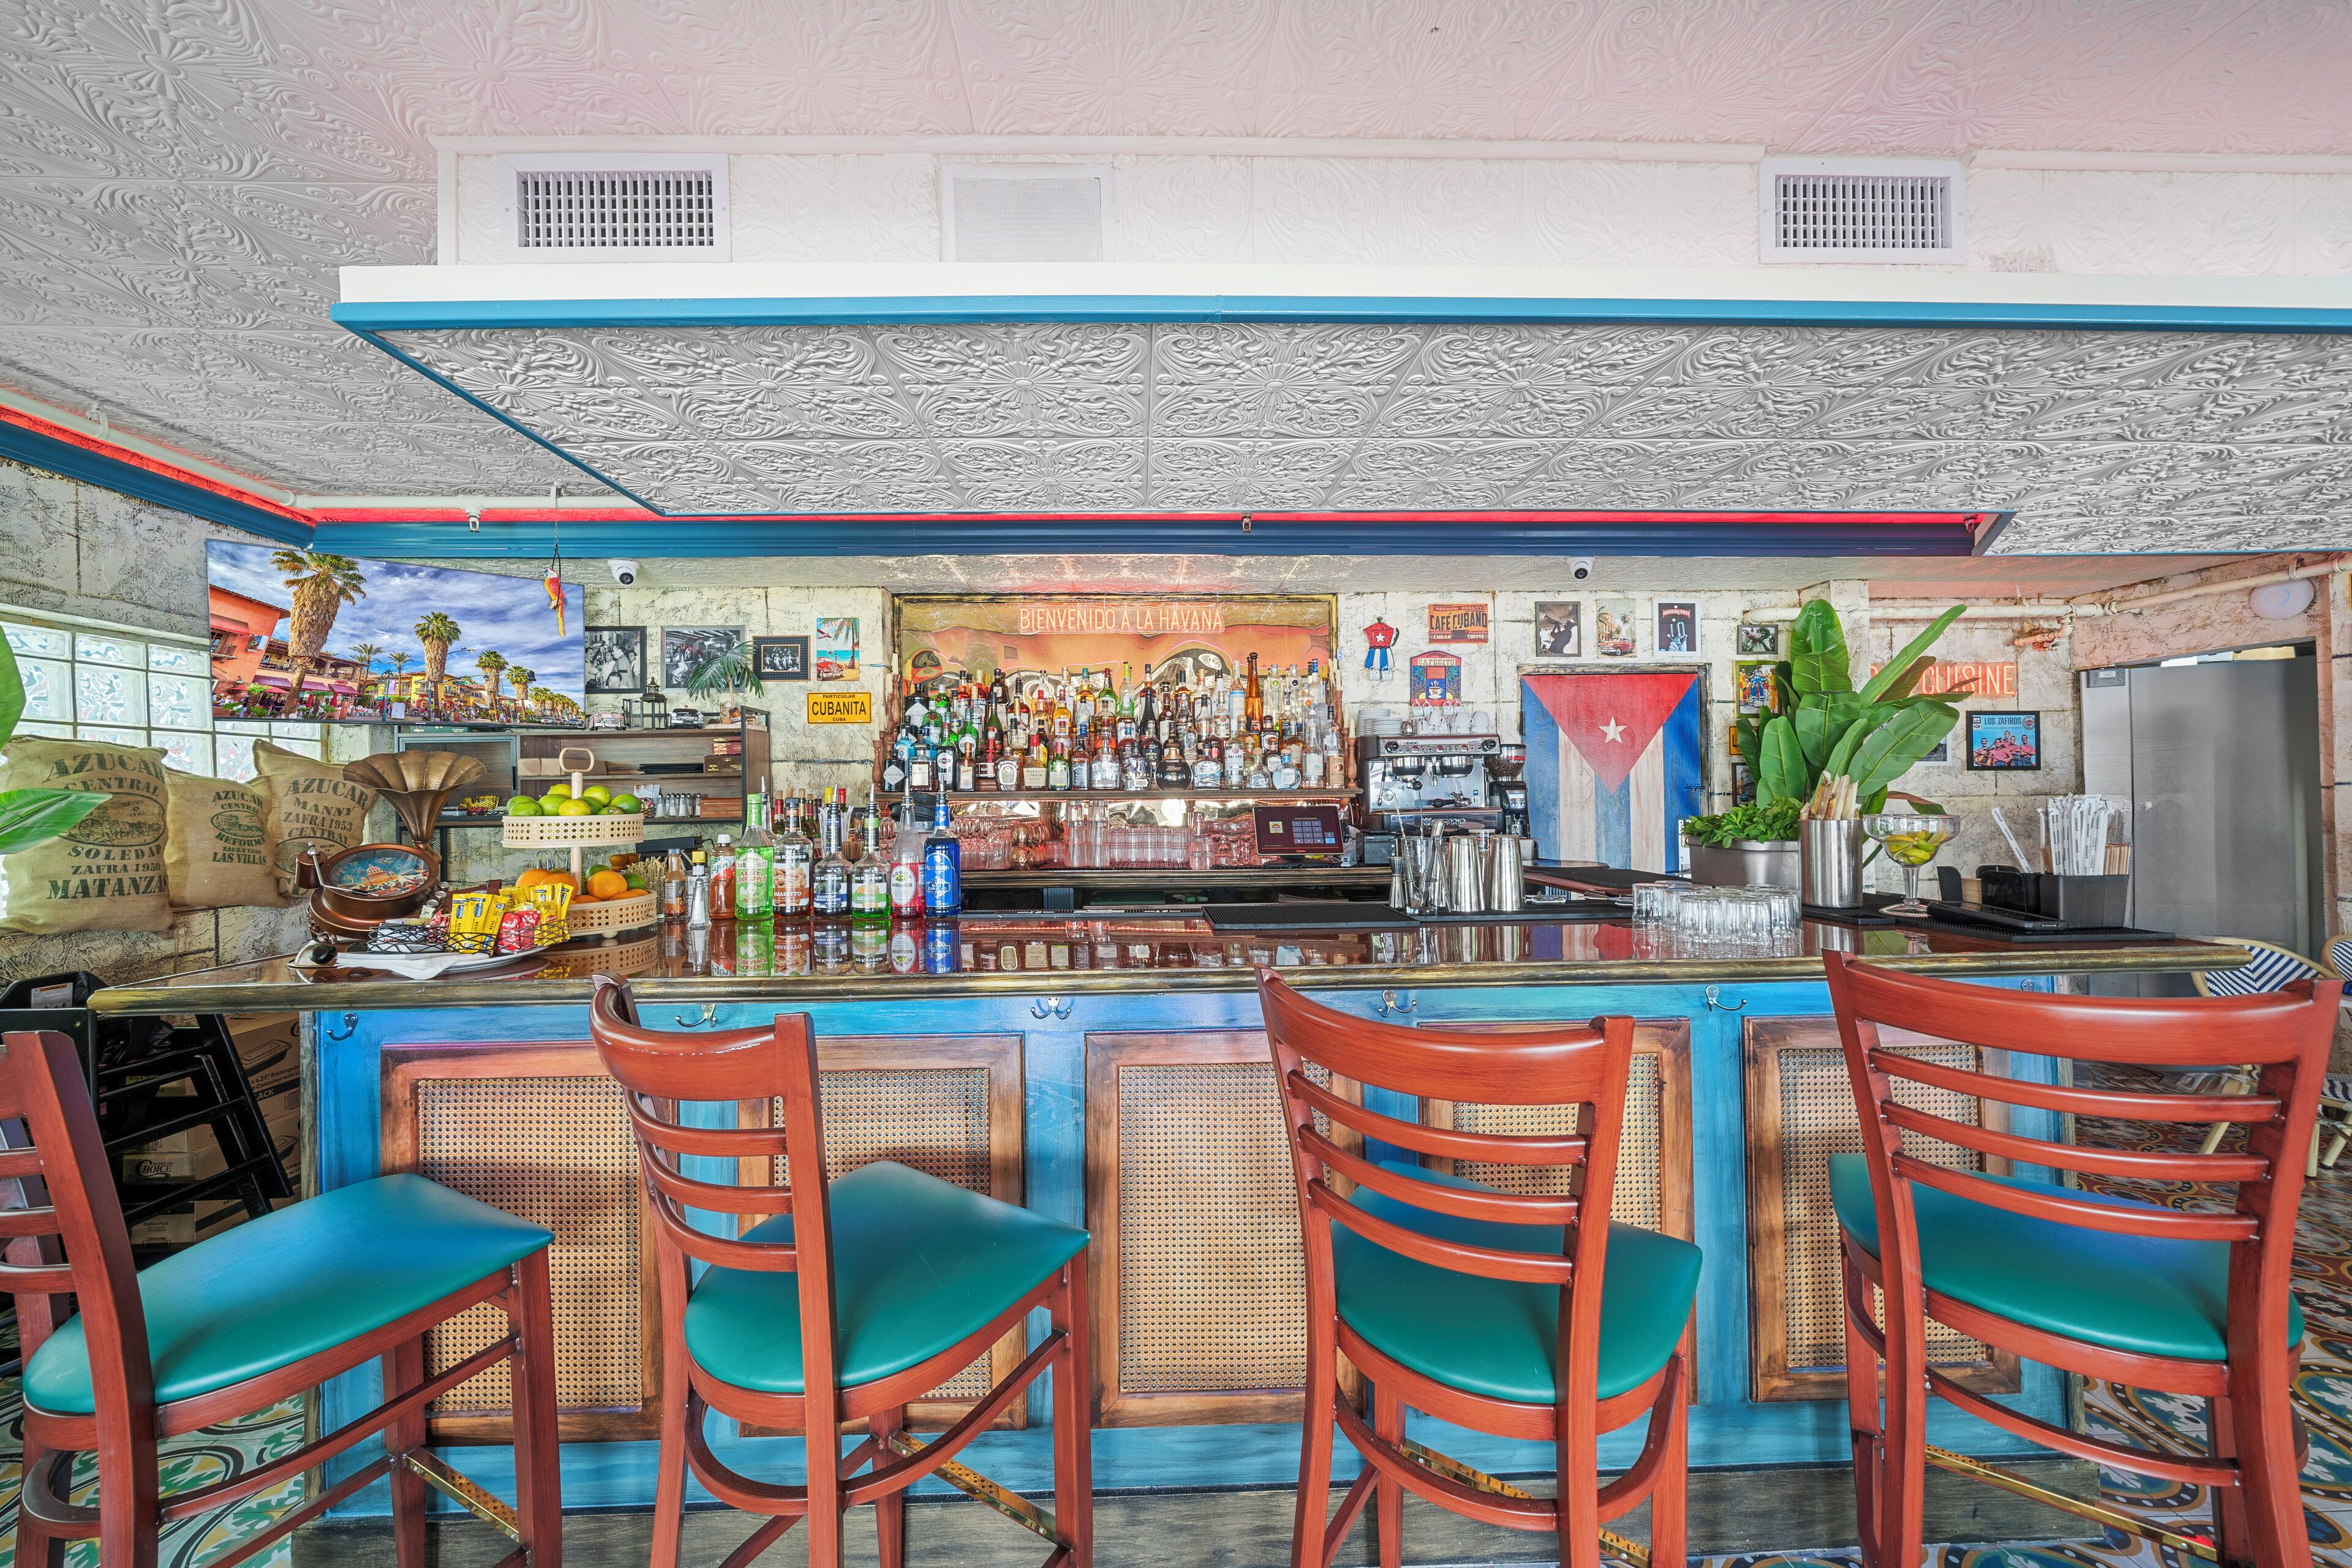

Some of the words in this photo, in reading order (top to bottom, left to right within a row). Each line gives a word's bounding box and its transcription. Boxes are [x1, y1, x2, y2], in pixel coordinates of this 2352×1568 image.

[1020, 608, 1115, 630] BIENVENIDO
[1121, 608, 1131, 630] A
[1137, 608, 1154, 630] LA
[1159, 608, 1223, 630] HAVANA
[1430, 612, 1451, 631] CAFÉ
[1452, 612, 1488, 629] CUBANO
[1922, 665, 2015, 695] CUISINE
[812, 701, 867, 716] CUBANITA
[42, 753, 165, 783] AZUCAR
[211, 791, 263, 809] AZUCAR
[282, 778, 369, 810] AZUCAR
[221, 803, 259, 815] CENTRAL
[294, 796, 355, 816] MANNY
[283, 812, 326, 827] ZAFRA
[329, 818, 353, 832] 1953
[215, 832, 266, 846] REFORMA
[287, 827, 350, 846] CENTRAL
[68, 844, 161, 861] SOLEDAD
[212, 852, 234, 863] LAS
[236, 853, 266, 865] VILLAS
[72, 864, 129, 875] ZAFRA
[132, 863, 160, 873] 1950
[255, 1074, 270, 1083] 6.25"
[256, 1077, 282, 1089] Container
[136, 1159, 173, 1177] CHOICE
